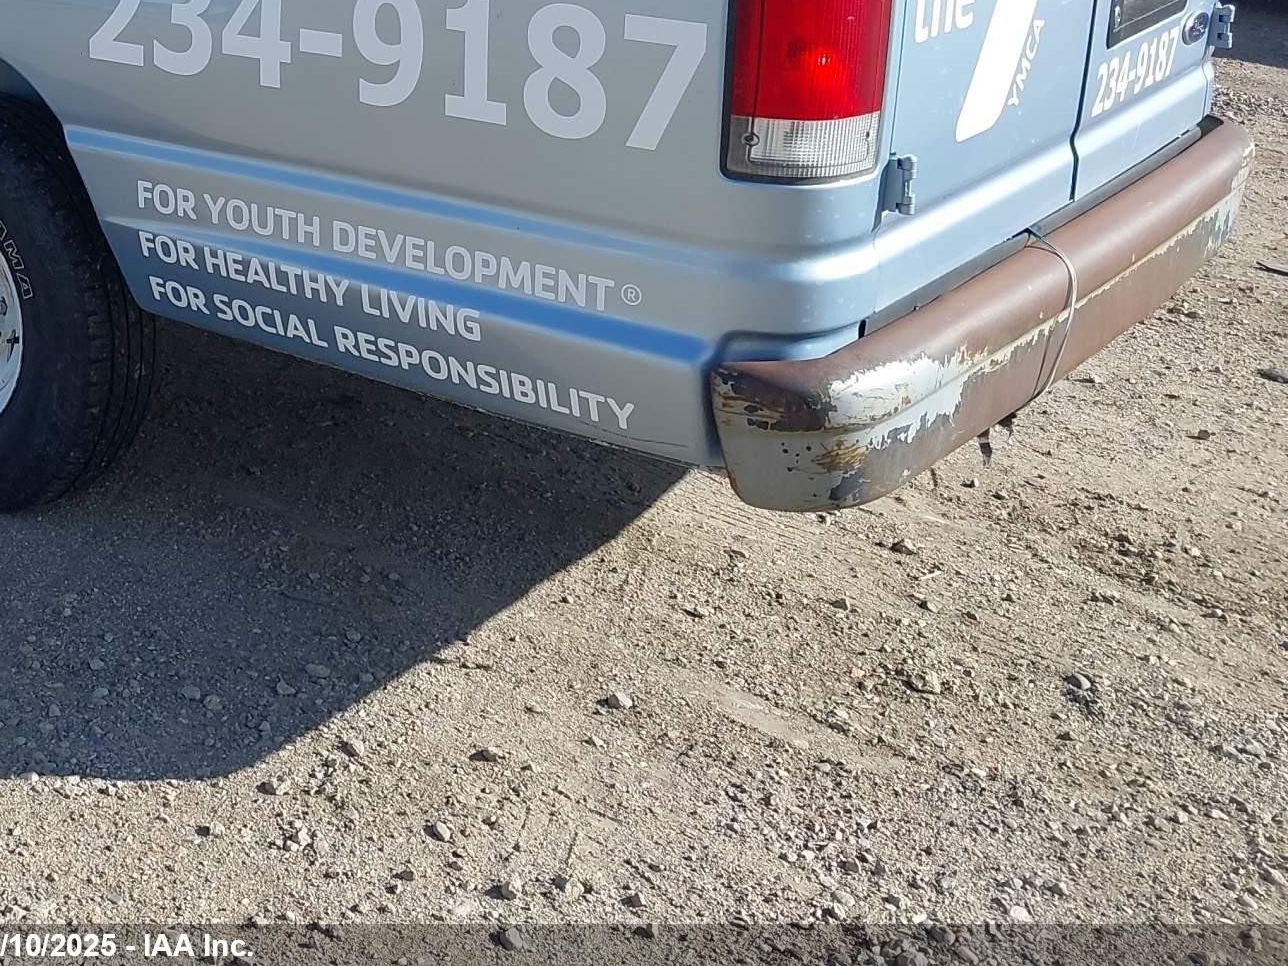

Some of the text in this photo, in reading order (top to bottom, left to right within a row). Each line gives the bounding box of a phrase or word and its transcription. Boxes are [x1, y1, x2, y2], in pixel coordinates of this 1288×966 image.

[1007, 18, 1045, 107] YMCA
[1091, 25, 1180, 117] 234-9187
[136, 180, 197, 221] FOR
[203, 193, 320, 247] YOUTH
[138, 231, 482, 342] FOR HEALTHY LIVING
[148, 274, 635, 431] FOR SOCIAL RESPONSIBILITY
